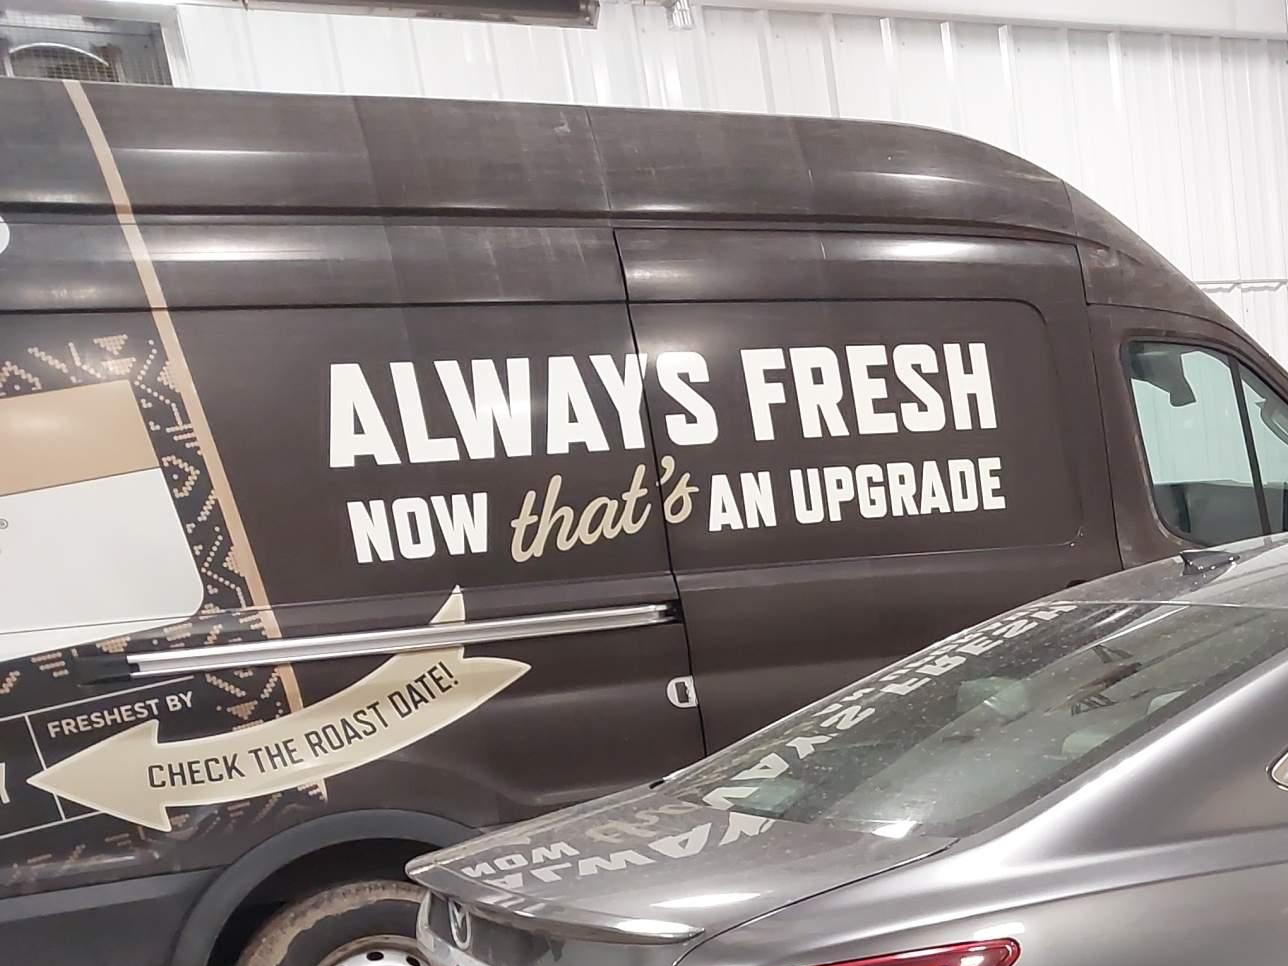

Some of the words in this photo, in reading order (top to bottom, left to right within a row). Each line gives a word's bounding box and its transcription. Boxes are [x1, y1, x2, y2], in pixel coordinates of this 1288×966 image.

[330, 352, 718, 468] ALWAYS
[740, 343, 998, 441] FRESH
[347, 492, 488, 563] NOW
[510, 455, 700, 562] that's
[709, 471, 777, 532] AN
[790, 457, 1006, 524] UPGRADE
[47, 699, 160, 738] FRESHEST
[166, 691, 193, 713] BY
[148, 753, 246, 789] CHECK
[249, 738, 304, 774] THE
[304, 702, 390, 758] ROAST
[387, 661, 459, 719] DATE!
